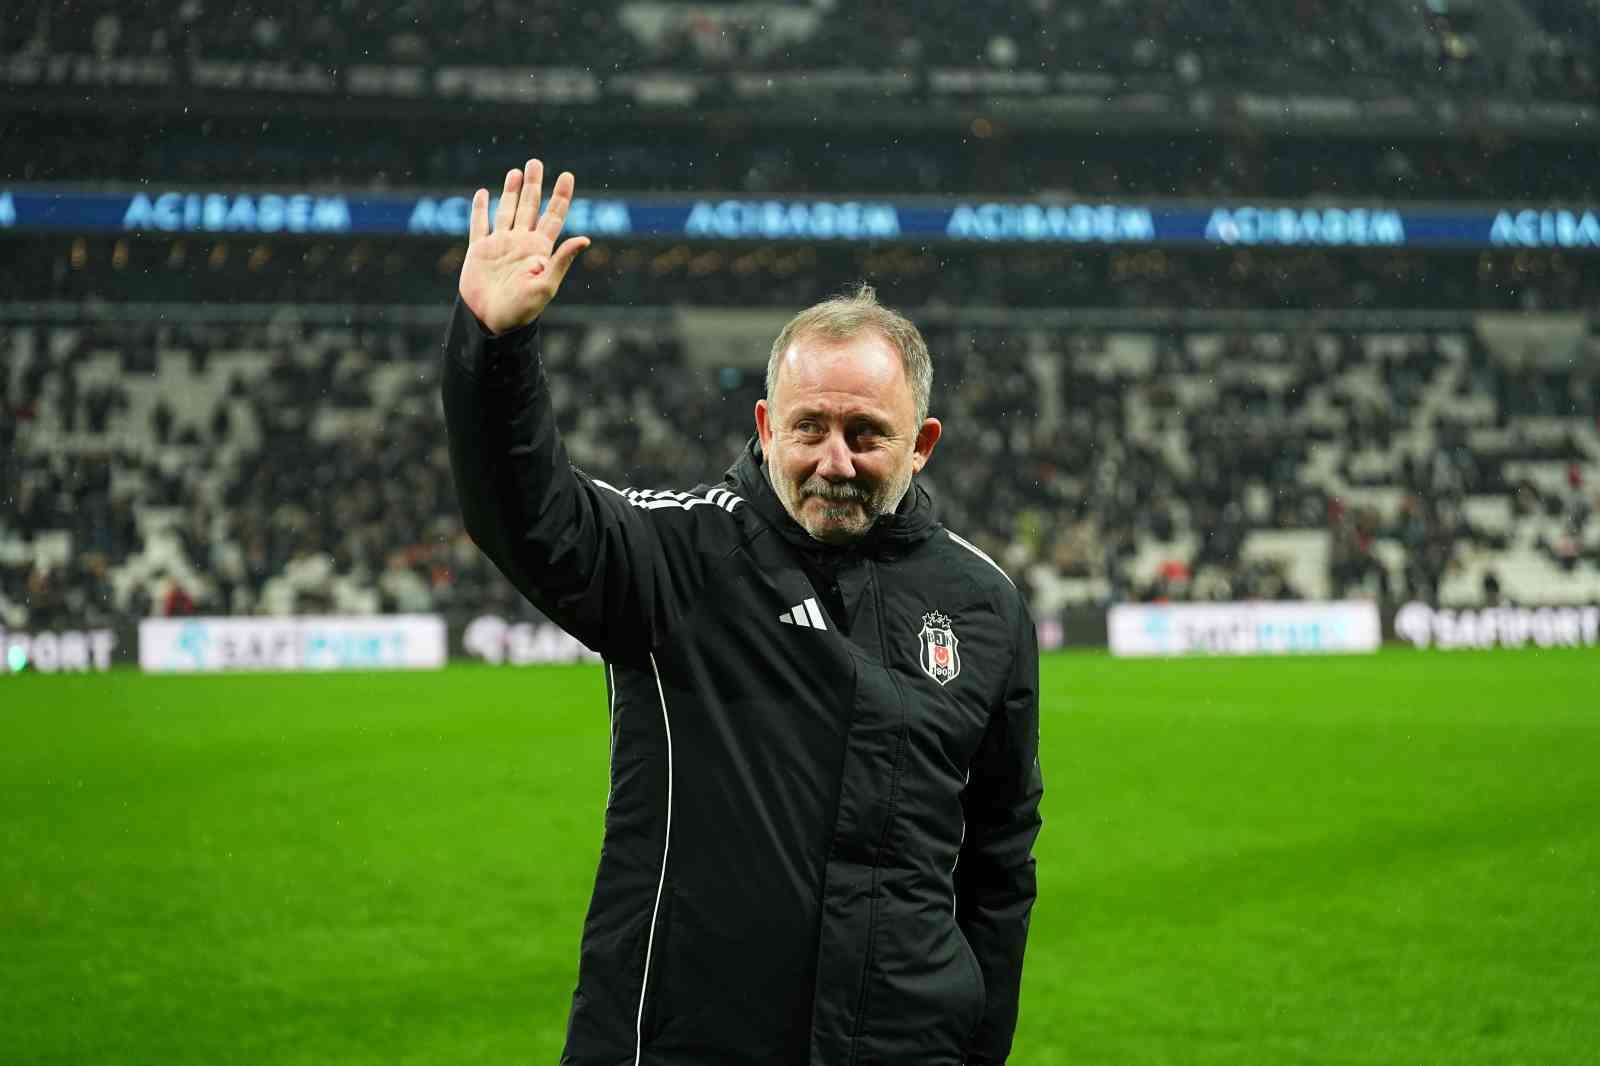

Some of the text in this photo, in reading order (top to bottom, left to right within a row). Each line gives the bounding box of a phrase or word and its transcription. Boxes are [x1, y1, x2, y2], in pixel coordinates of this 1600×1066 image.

[124, 192, 350, 231] ACIBADEM
[685, 200, 898, 238] ACIBADEM
[947, 203, 1154, 240] ACIBADEM
[1205, 206, 1405, 245] ACIBADEM
